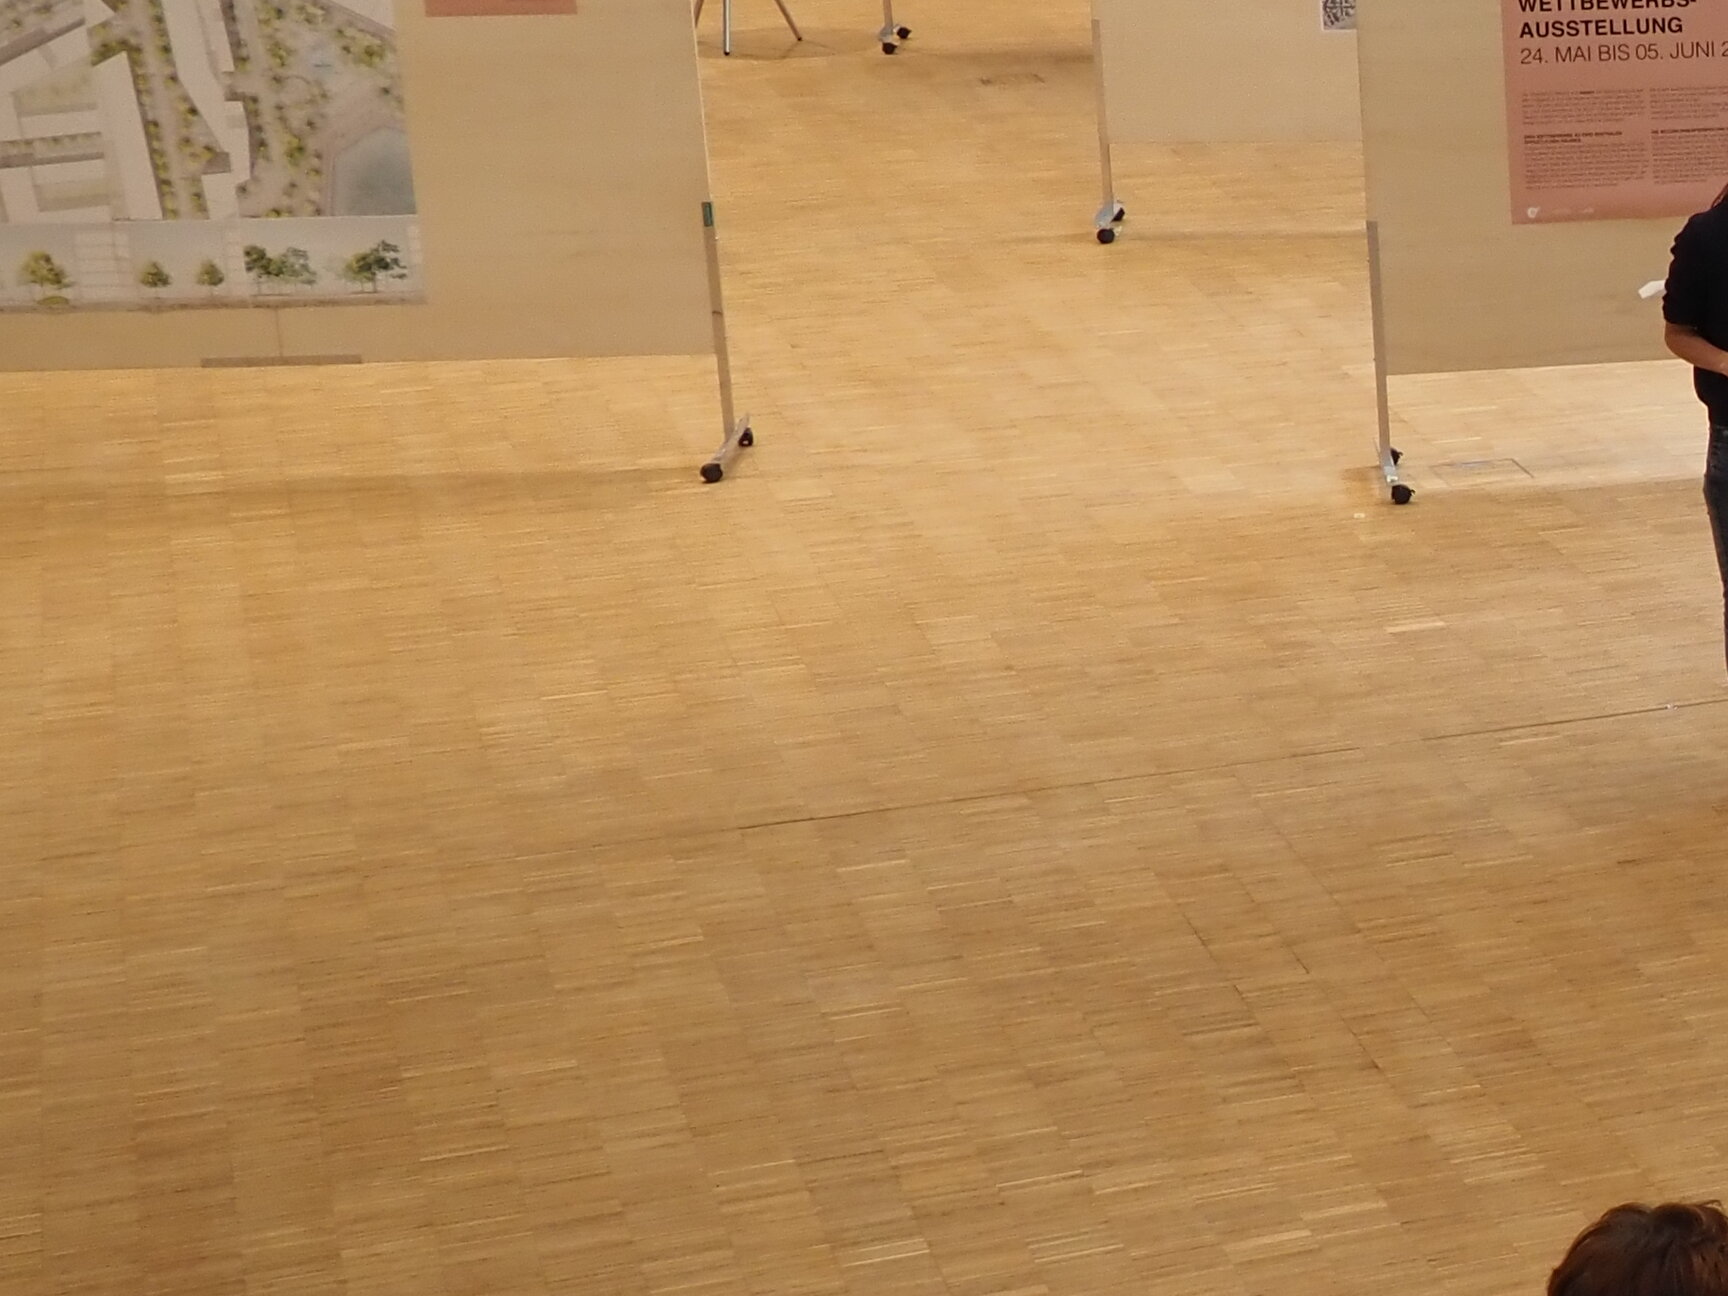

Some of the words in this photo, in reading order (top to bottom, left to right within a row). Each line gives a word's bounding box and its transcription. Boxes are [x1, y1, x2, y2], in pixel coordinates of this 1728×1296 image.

[1519, 17, 1683, 38] AUSSTELLUNG
[1520, 47, 1548, 64] 24.
[1555, 46, 1592, 63] MAI
[1598, 44, 1630, 61] BIS
[1635, 43, 1664, 61] 05.
[1669, 41, 1715, 60] JUNI
